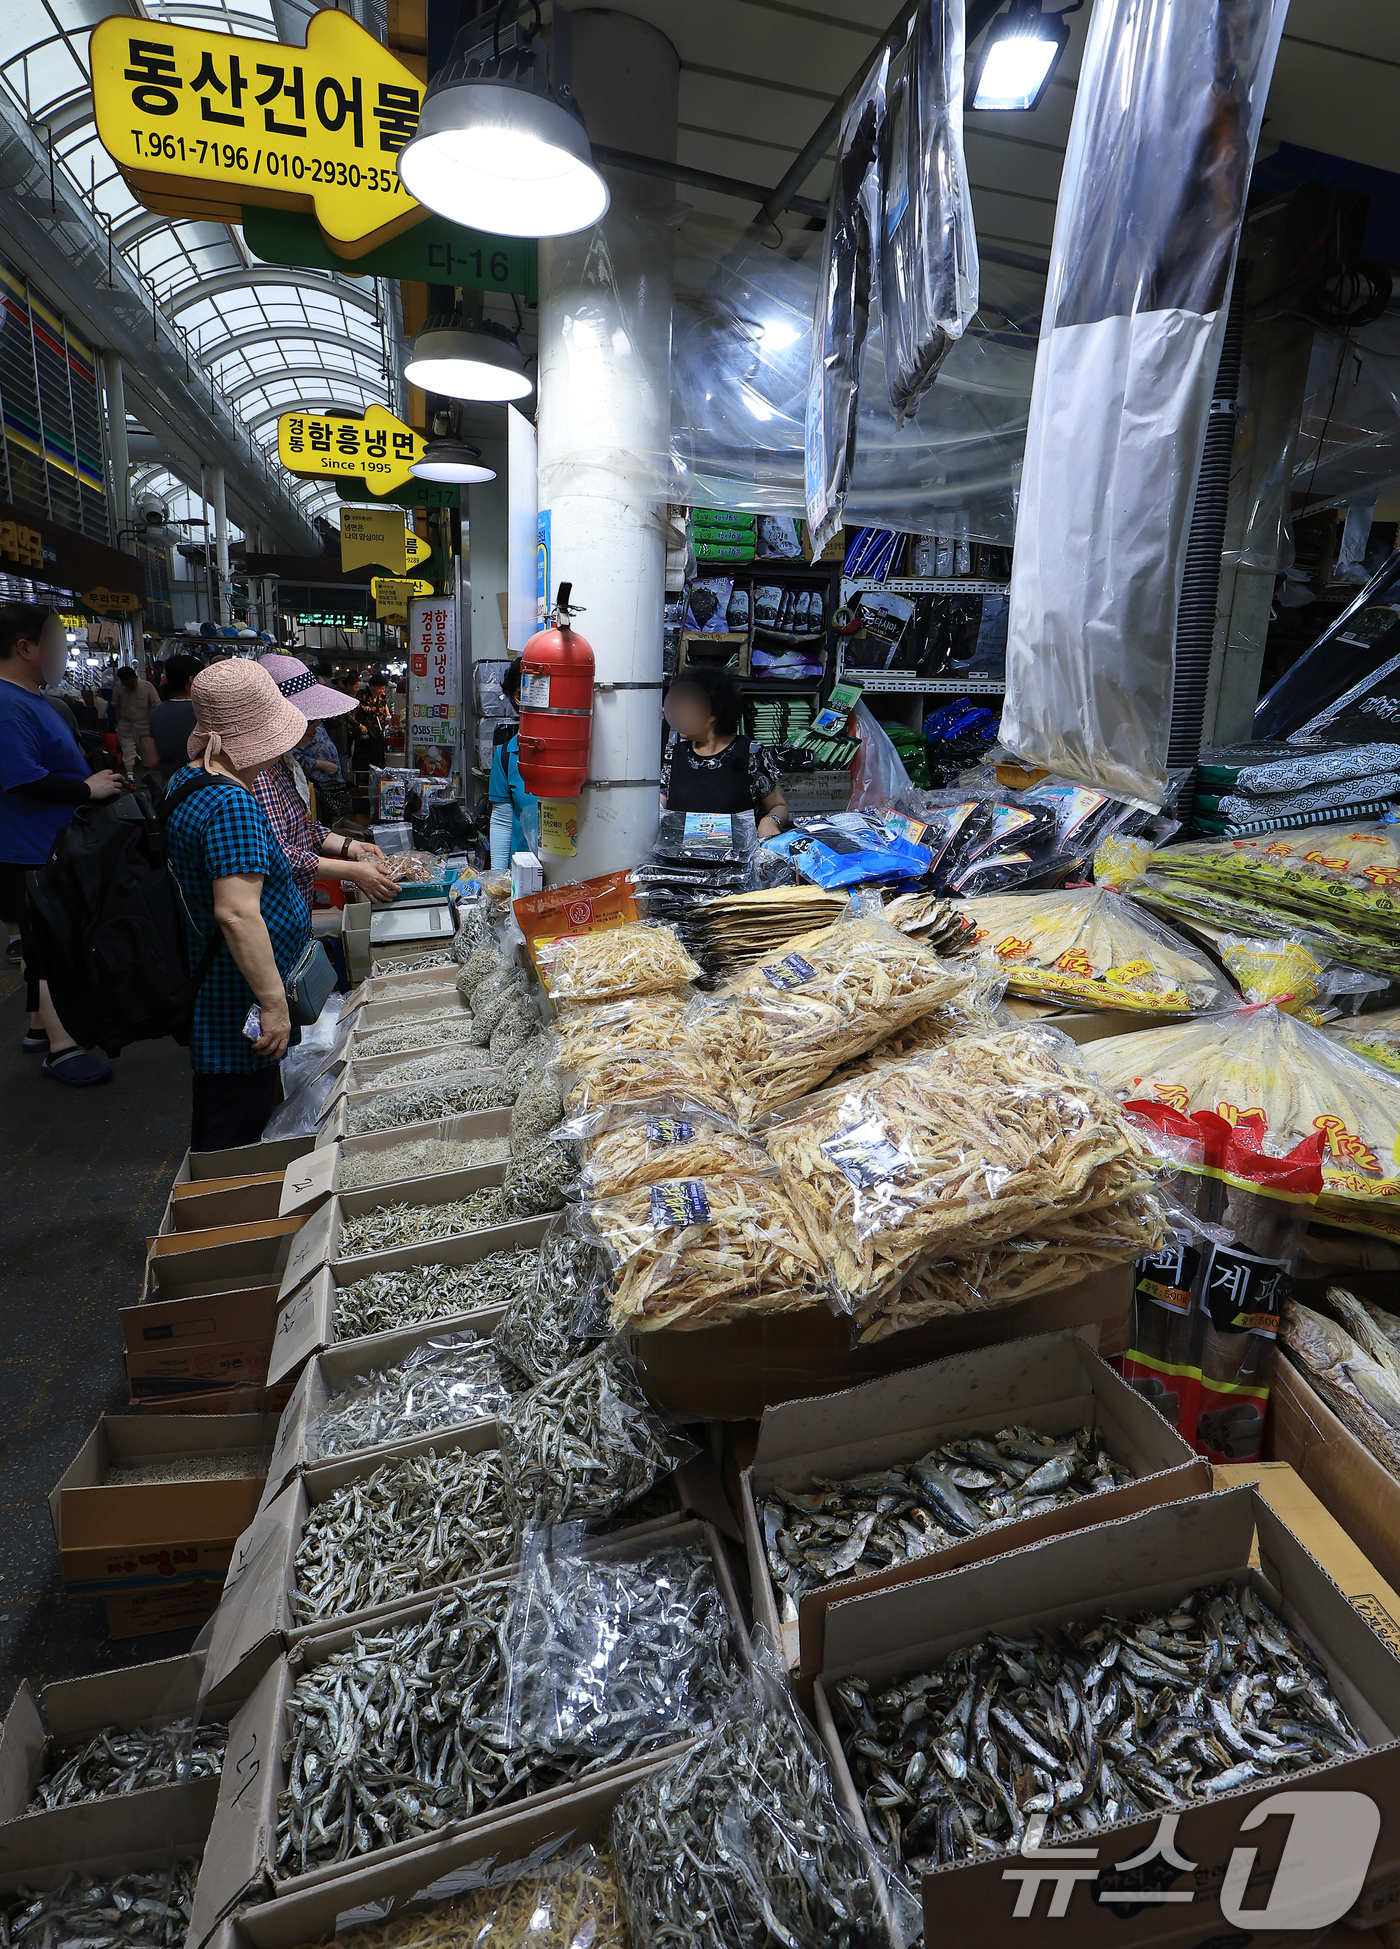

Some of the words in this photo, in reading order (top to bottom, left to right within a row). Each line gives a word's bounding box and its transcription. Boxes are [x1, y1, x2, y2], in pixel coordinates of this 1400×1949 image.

[123, 37, 419, 153] 동산건어물
[131, 129, 249, 171] T.961-7196
[266, 151, 414, 197] 010-2930-357
[428, 242, 510, 282] 다-16
[307, 421, 414, 461] 함흥냉면
[320, 457, 355, 470] Since
[360, 461, 392, 473] 1995
[417, 487, 454, 504] 다-17
[344, 523, 364, 532] 냉면은
[344, 532, 358, 540] 나의
[359, 533, 385, 542] 양심이다
[89, 593, 130, 605] 우리약국
[421, 610, 433, 653] 경동
[434, 609, 448, 696] 함흥냉면
[418, 725, 431, 735] SBS
[662, 1185, 689, 1222] 황태채
[1135, 1245, 1184, 1286] 피
[1210, 1264, 1281, 1311] 계피
